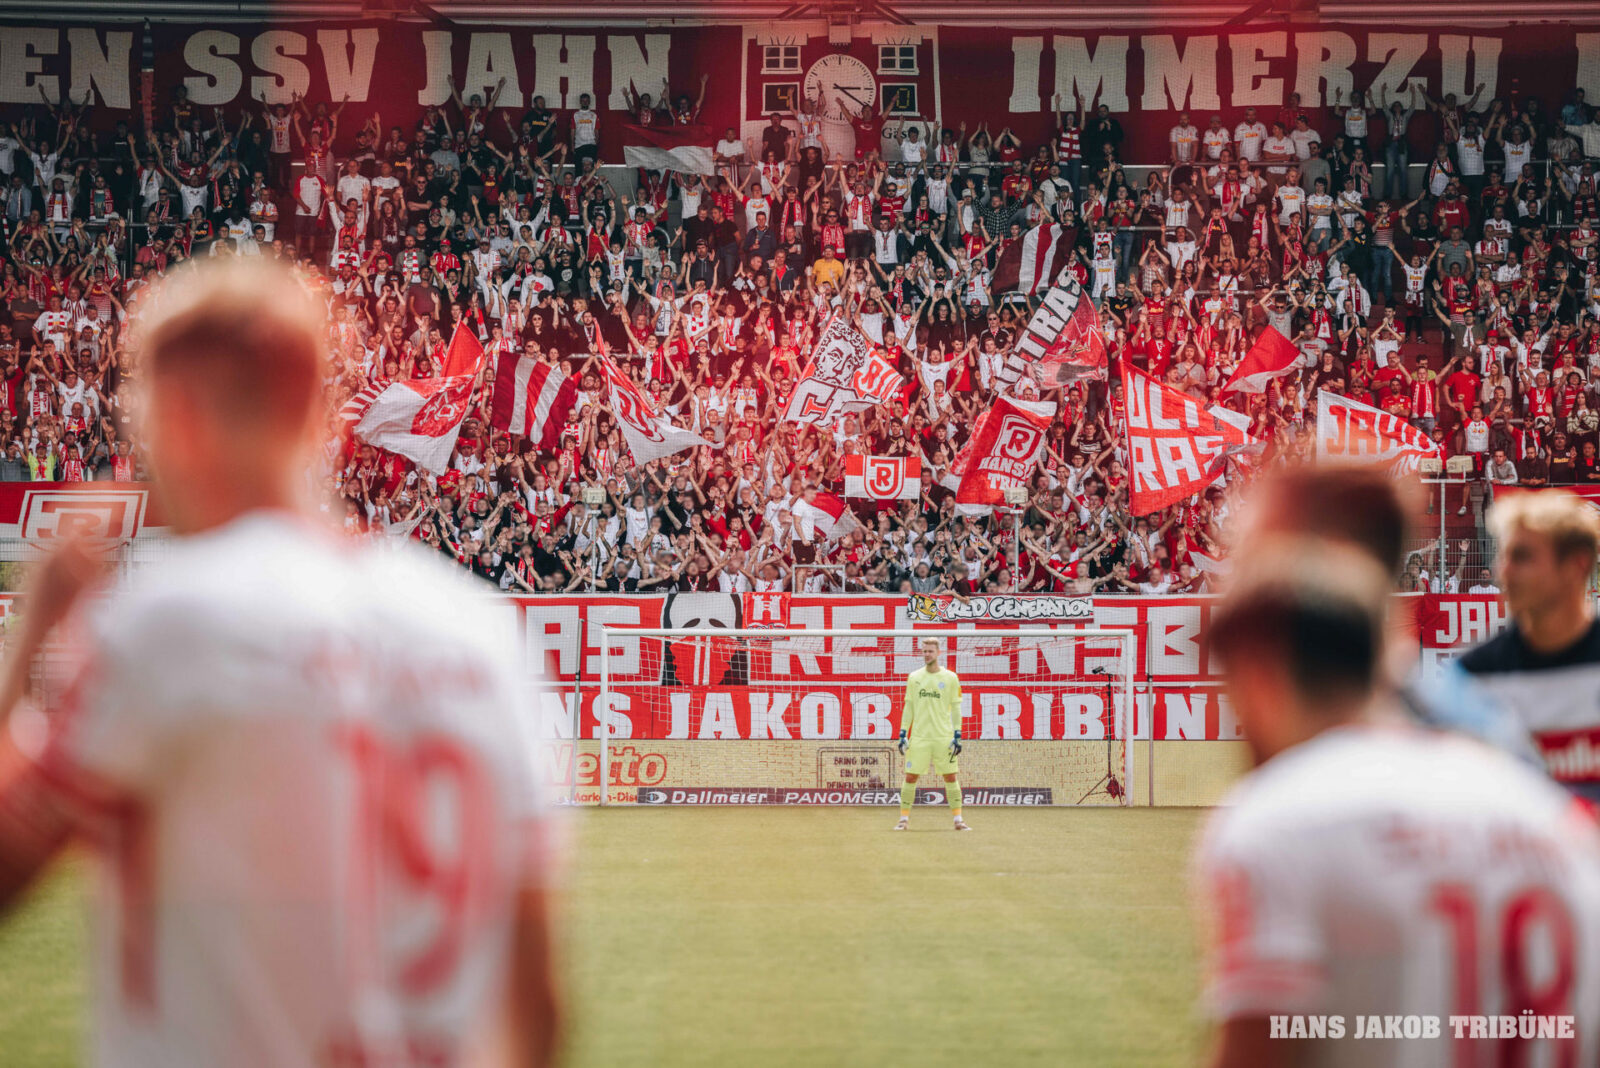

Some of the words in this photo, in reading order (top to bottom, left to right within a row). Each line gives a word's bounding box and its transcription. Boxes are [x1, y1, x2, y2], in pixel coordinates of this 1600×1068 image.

[183, 28, 379, 105] SSV
[418, 29, 671, 111] JAHN
[1009, 31, 1503, 113] IMMERZU
[946, 599, 988, 619] RED
[988, 597, 1095, 619] GENERATION
[665, 691, 893, 739] JAKOB
[671, 790, 767, 804] Dallmeier
[784, 792, 902, 804] PANOMERA
[963, 791, 1044, 805] allmeier
